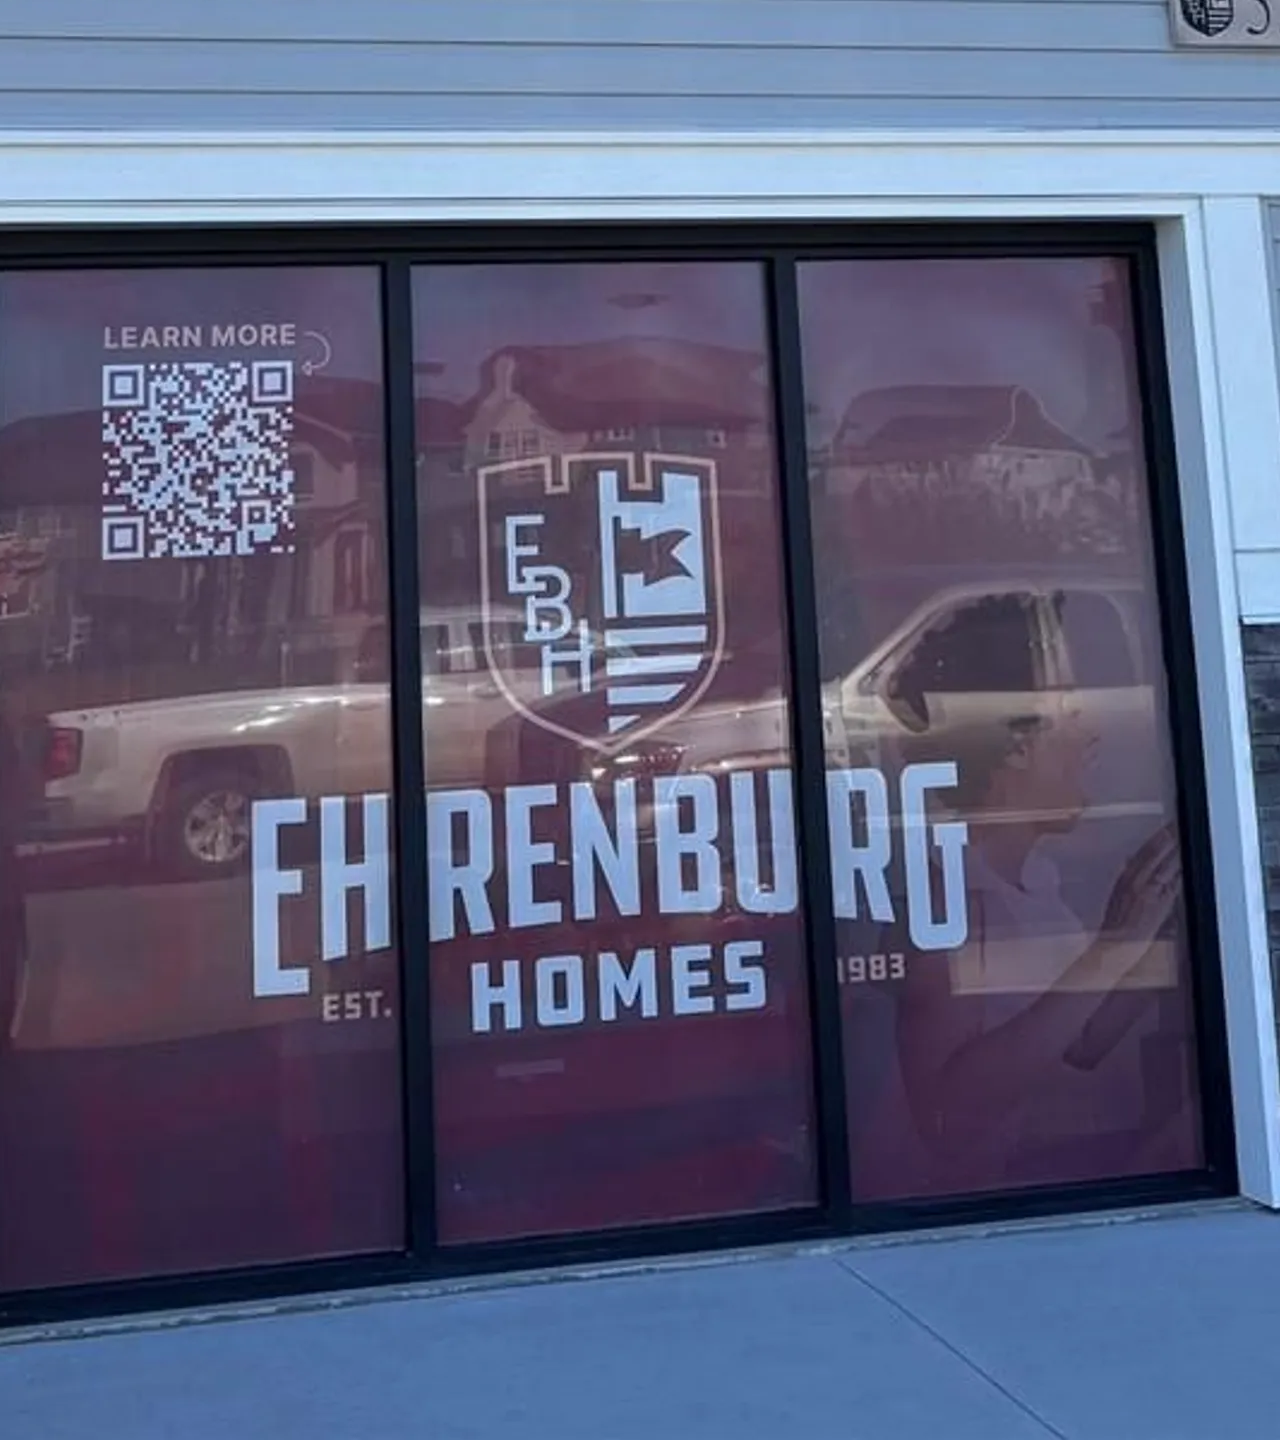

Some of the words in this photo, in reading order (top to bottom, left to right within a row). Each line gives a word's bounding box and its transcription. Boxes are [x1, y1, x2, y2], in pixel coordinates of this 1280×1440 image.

[104, 326, 202, 349] LEARN
[211, 323, 296, 347] MORE
[250, 762, 969, 997] EHRENBURG
[837, 953, 905, 983] 1983
[471, 940, 766, 1033] HOMES
[323, 990, 392, 1021] EST.
